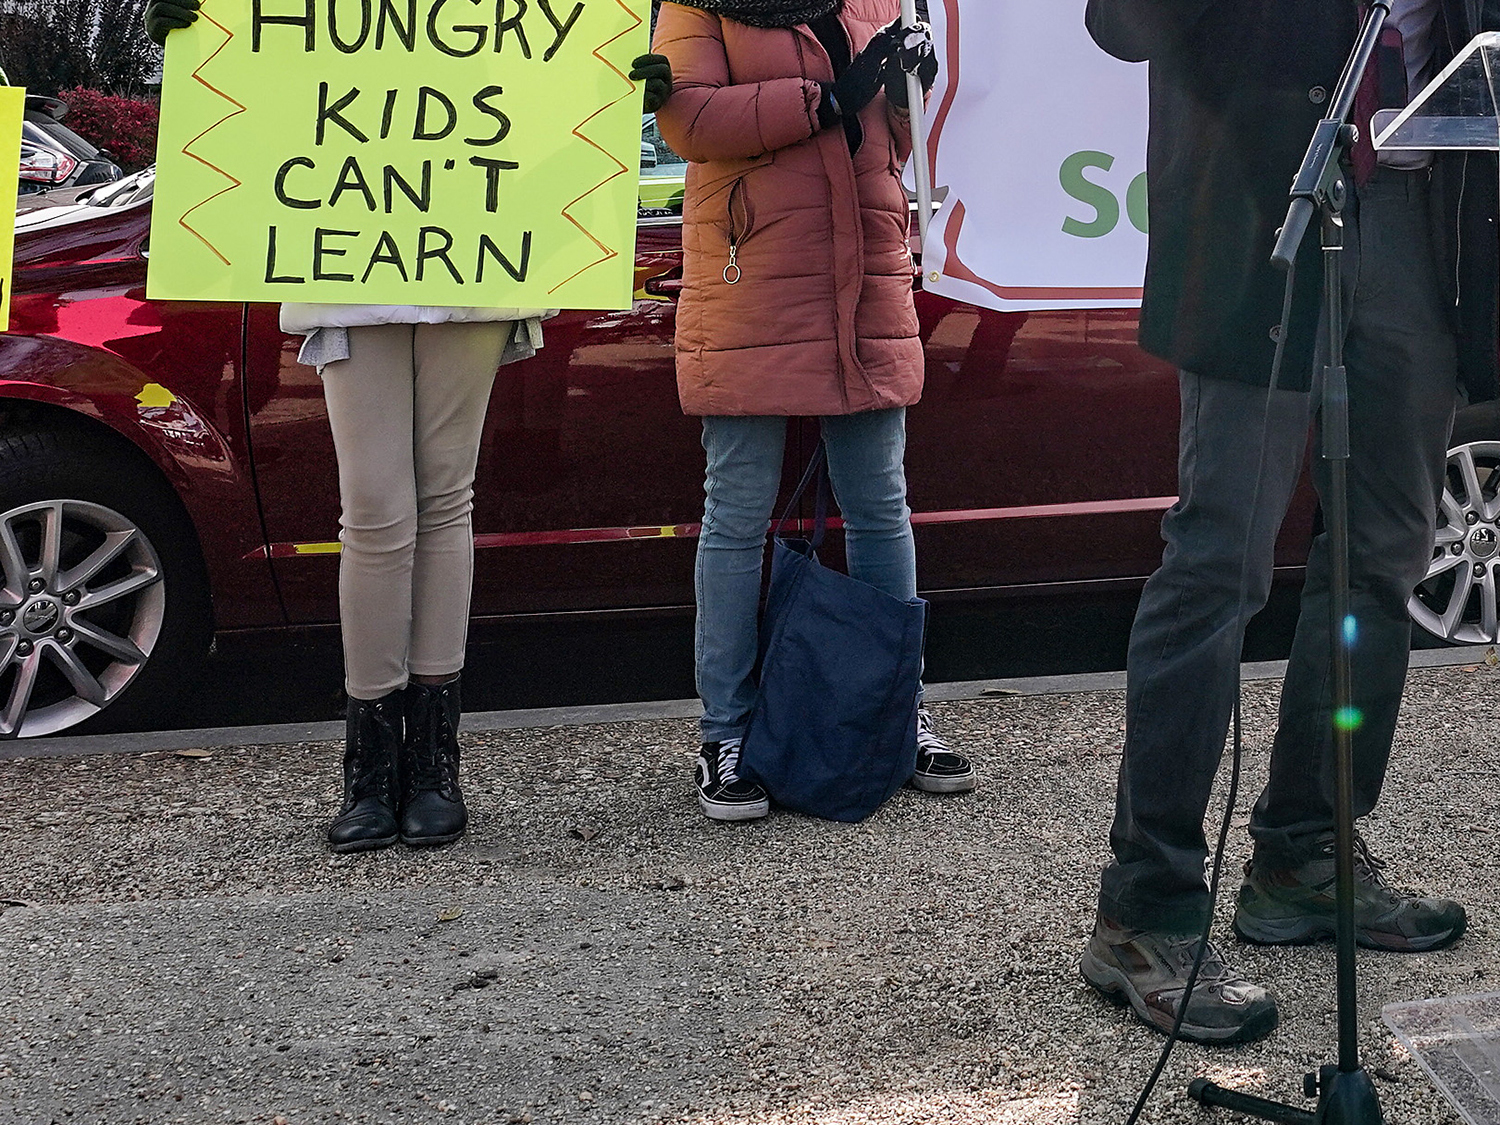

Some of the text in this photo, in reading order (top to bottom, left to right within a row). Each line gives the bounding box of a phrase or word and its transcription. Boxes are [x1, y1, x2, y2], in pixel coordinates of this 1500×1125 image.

[315, 81, 511, 146] KIDS
[274, 156, 518, 213] CAN'T
[265, 226, 531, 285] LEARN
